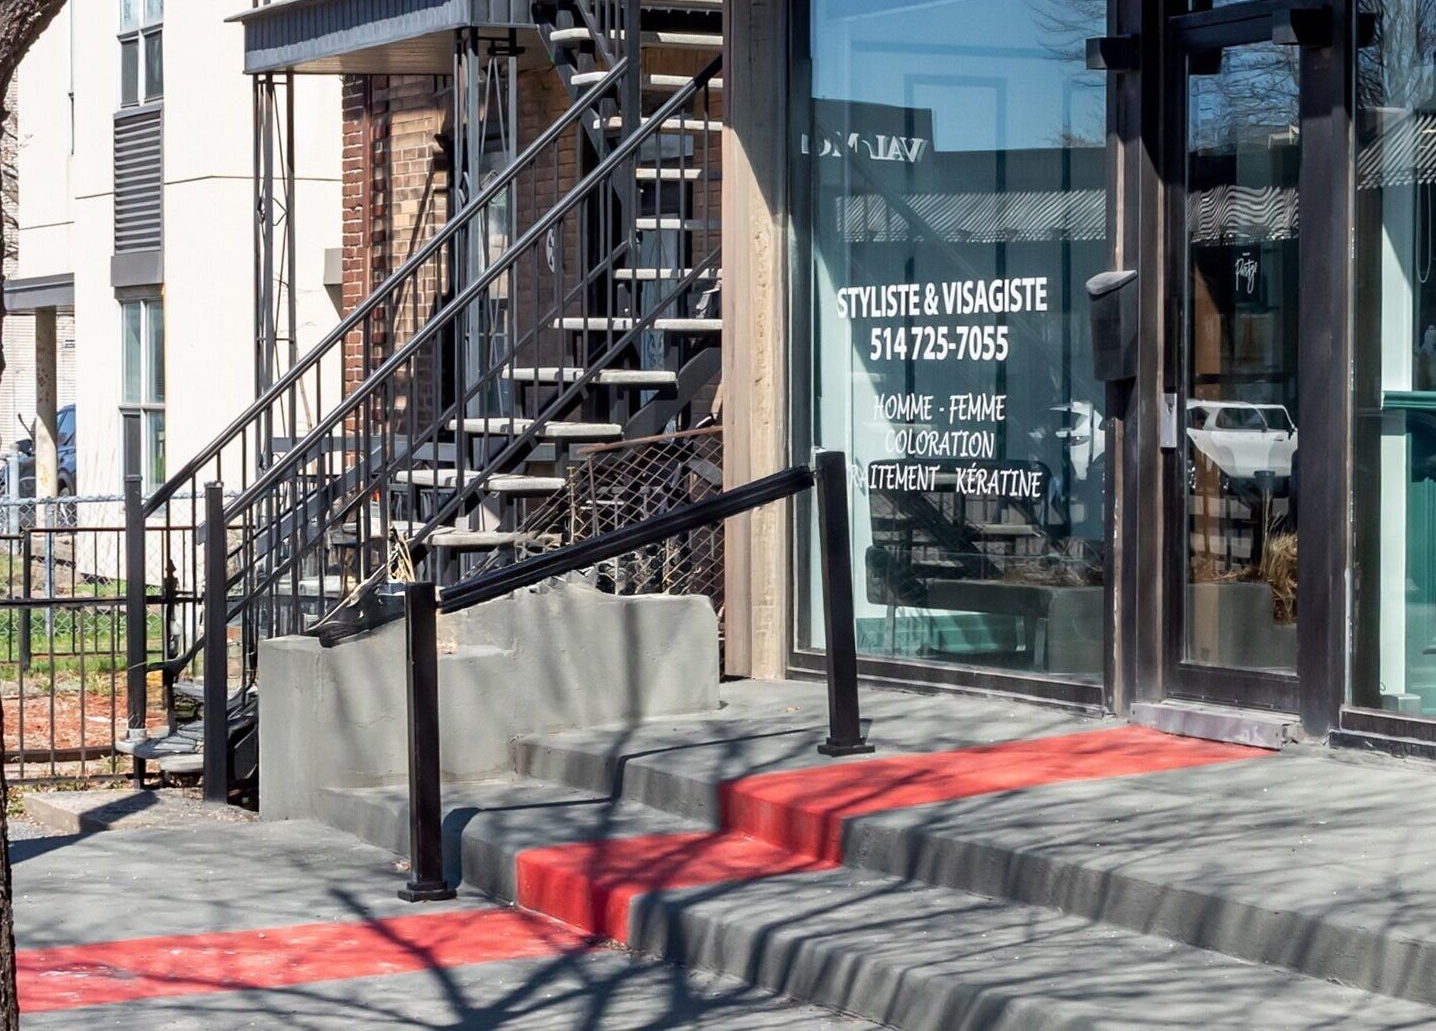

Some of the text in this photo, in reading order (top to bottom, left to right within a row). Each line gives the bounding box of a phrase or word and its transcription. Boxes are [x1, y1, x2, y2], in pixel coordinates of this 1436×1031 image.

[837, 276, 1048, 319] STYLISTE & VISAGISTE
[870, 325, 1009, 361] 514 725-7055
[873, 393, 934, 421] HOMME
[950, 393, 1006, 424] FEMME
[885, 429, 995, 458] COLORATION
[955, 461, 1043, 498] KÉRATINE
